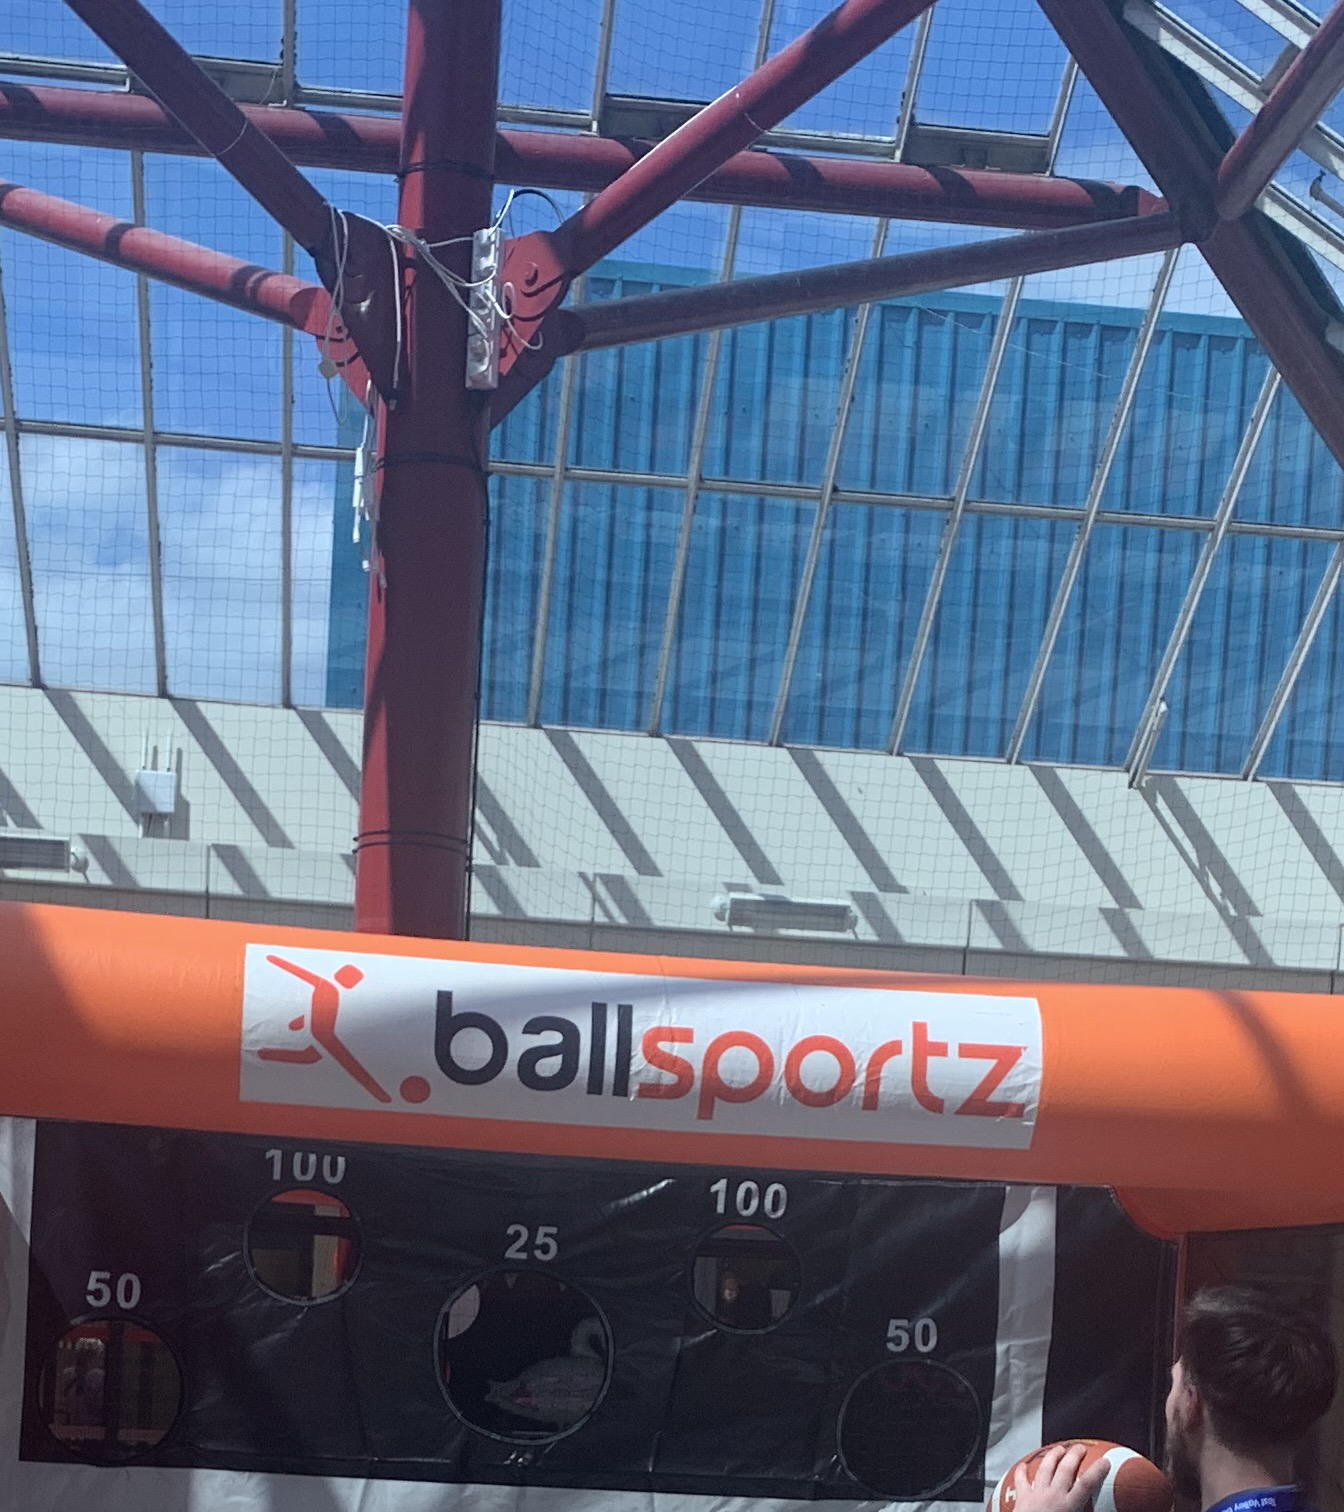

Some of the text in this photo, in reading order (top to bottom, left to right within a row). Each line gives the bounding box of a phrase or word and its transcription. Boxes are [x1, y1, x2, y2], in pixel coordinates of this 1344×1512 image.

[436, 990, 1027, 1120] ballsportz
[265, 1148, 346, 1184] 100
[709, 1178, 788, 1219] 100
[504, 1223, 558, 1262] 25
[86, 1270, 142, 1310] 50
[885, 1317, 939, 1354] 50
[1234, 1498, 1262, 1512] Valley
